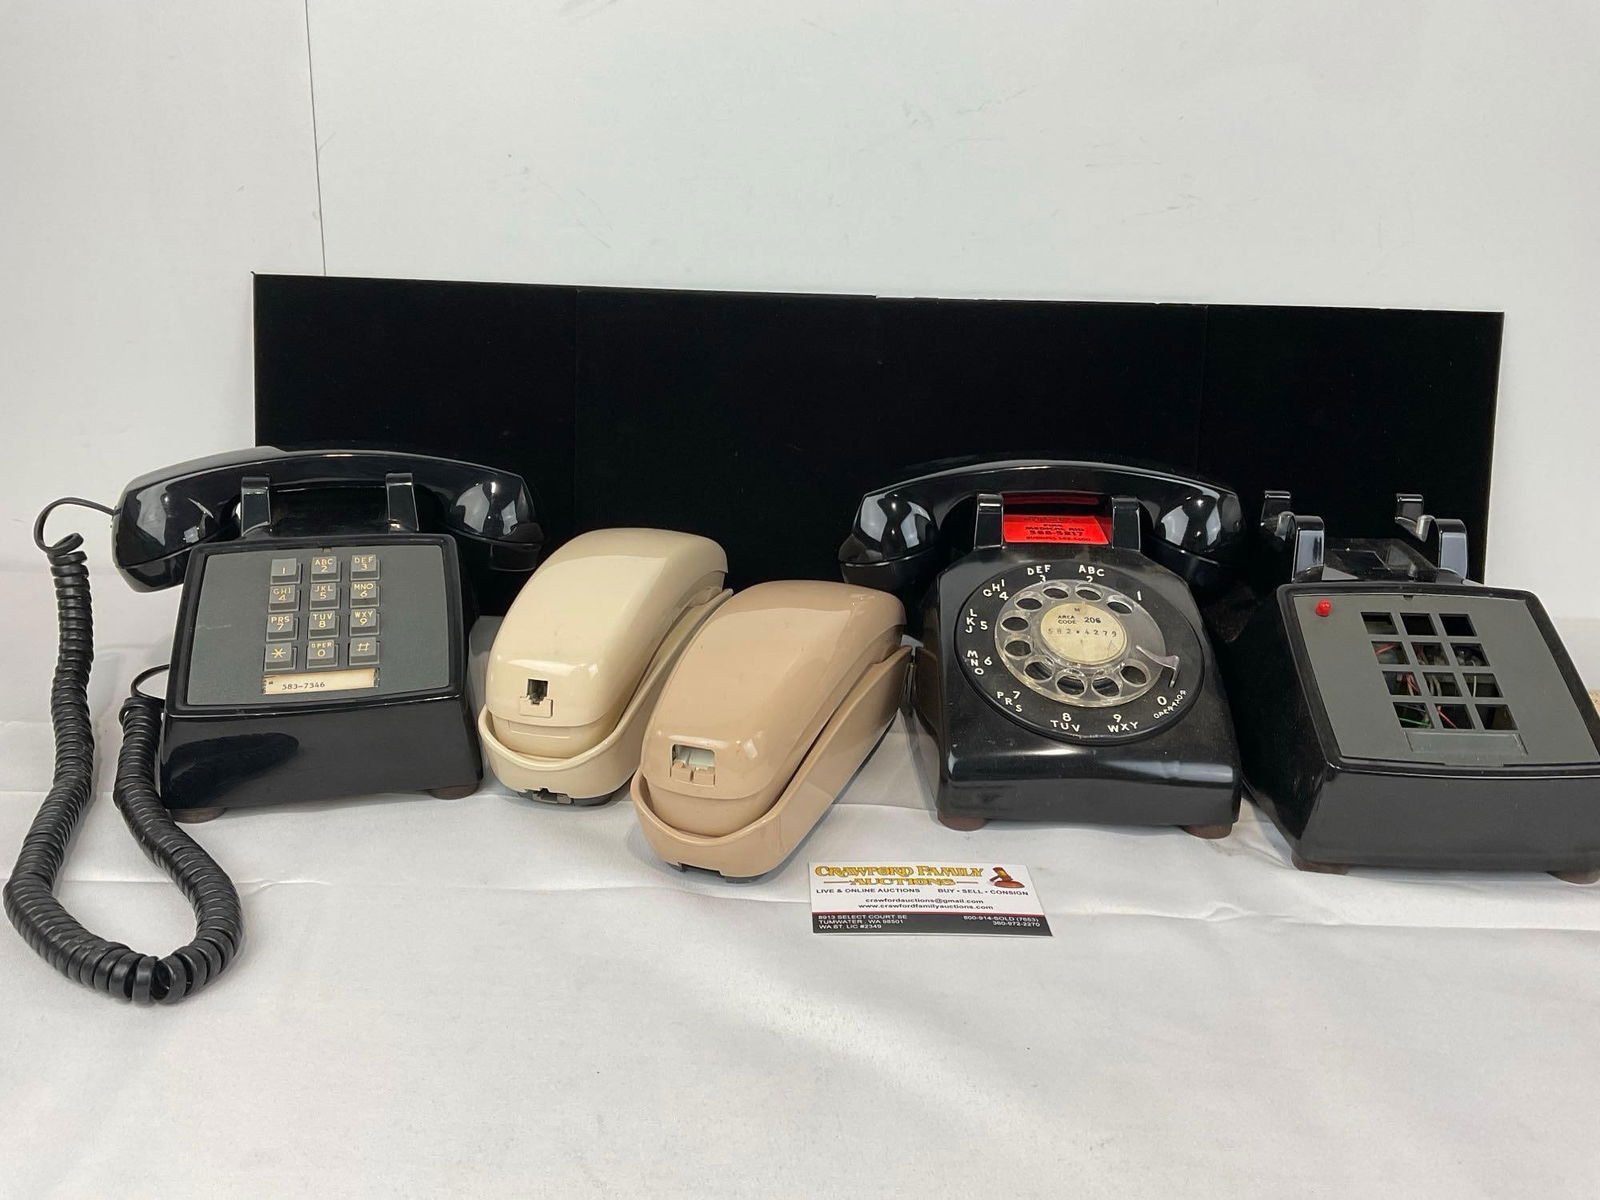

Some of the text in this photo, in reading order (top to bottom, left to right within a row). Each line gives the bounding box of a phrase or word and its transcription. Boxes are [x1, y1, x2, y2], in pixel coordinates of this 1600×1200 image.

[314, 558, 333, 566] ABC
[354, 556, 374, 564] DEF
[321, 565, 329, 573] 2
[361, 563, 368, 571] 3
[1027, 564, 1051, 575] DEF
[1078, 564, 1105, 577] ABC
[273, 587, 291, 596] GHI
[314, 585, 333, 593] JKL
[354, 583, 374, 591] MNO
[320, 592, 327, 600] 5
[360, 590, 368, 598] 6
[999, 591, 1009, 601] 4
[313, 613, 333, 621] TUV
[354, 610, 374, 619] WXY
[271, 615, 290, 624] PRS
[319, 620, 326, 628] 8
[359, 617, 368, 626] 9
[1084, 616, 1102, 624] 206
[277, 623, 284, 631] 7
[980, 620, 988, 631] 5
[984, 656, 993, 666] 6
[282, 681, 326, 691] 583-7346
[1012, 690, 1021, 700] 7
[1153, 689, 1187, 719] OPERATOR
[1062, 712, 1072, 722] 8
[1113, 713, 1122, 723] 9
[1050, 719, 1081, 733] TUV
[1107, 721, 1139, 733] WXY
[917, 865, 984, 877] FAMILY
[848, 877, 956, 886] AUCTIONS
